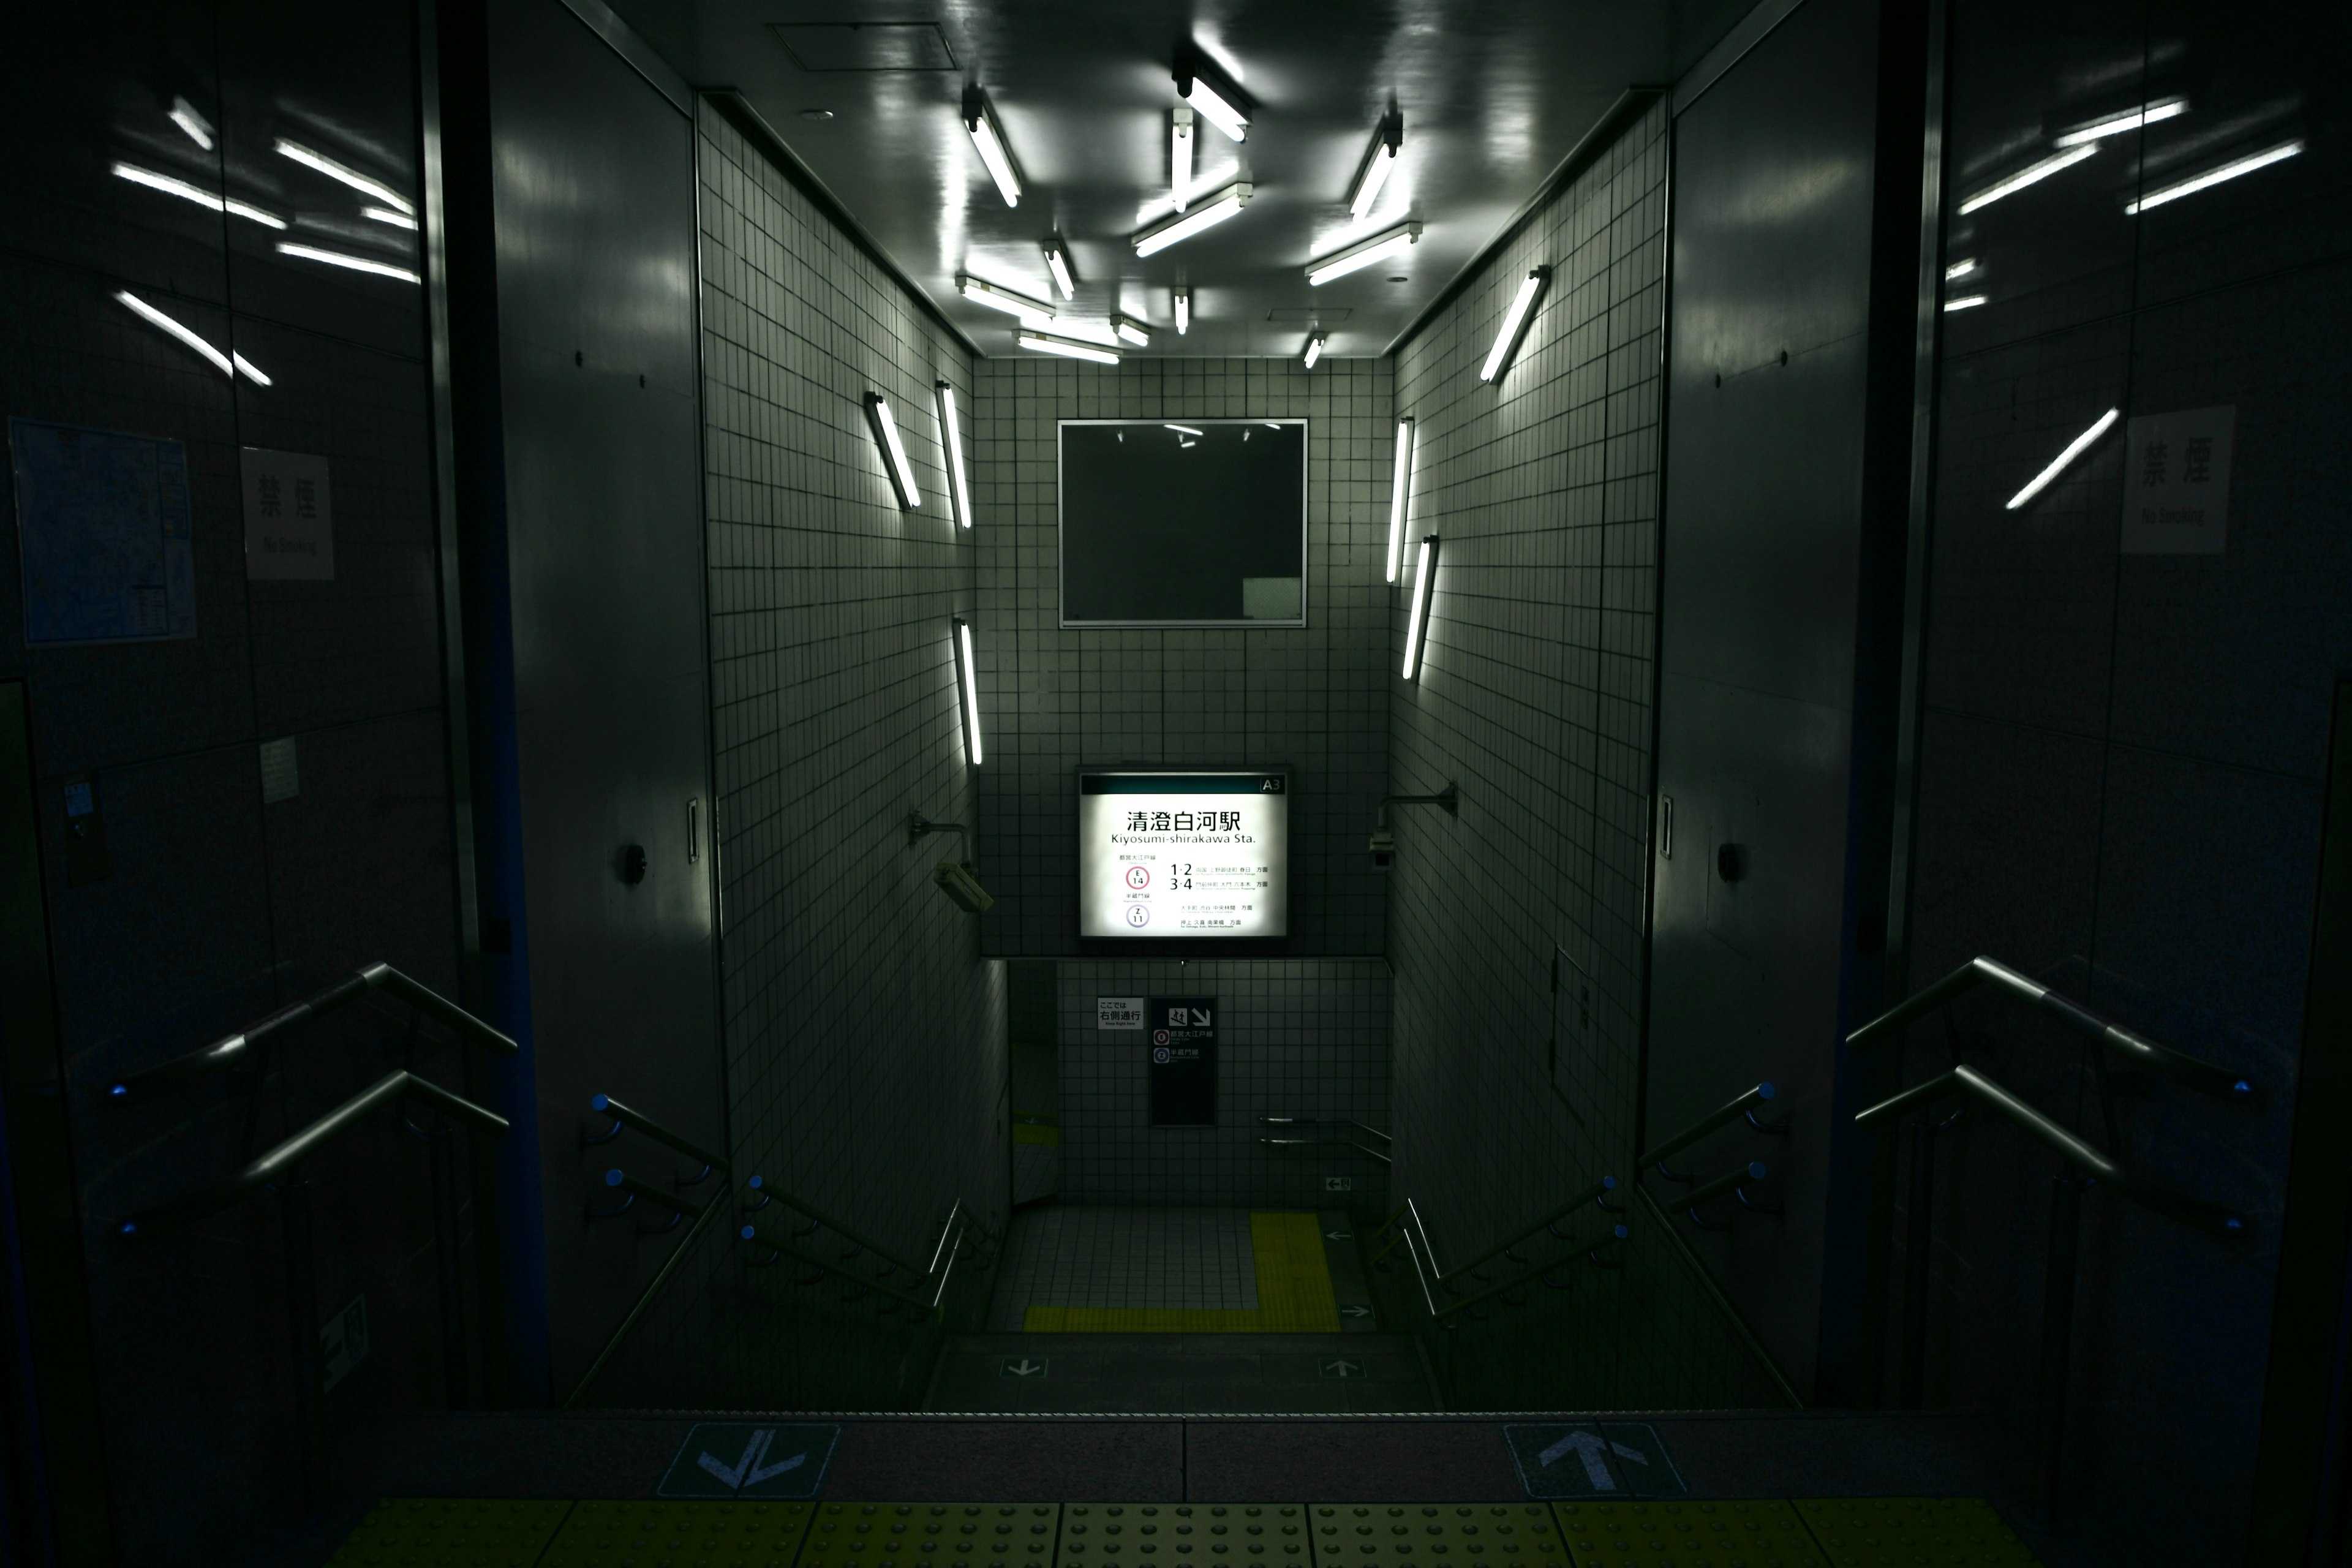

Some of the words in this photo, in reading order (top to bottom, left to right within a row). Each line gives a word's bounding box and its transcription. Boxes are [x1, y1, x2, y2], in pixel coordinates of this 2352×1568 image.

[2143, 436, 2213, 487] 禁煙
[258, 473, 317, 519] 禁煙
[2143, 507, 2157, 525] No
[2159, 507, 2205, 527] Smoking
[264, 537, 277, 553] No
[279, 537, 317, 557] Smoking
[1262, 778, 1281, 790] A3
[1127, 811, 1241, 832] 清澄白河駅
[1111, 834, 1231, 846] Kiyosumi-shirakawa
[1234, 834, 1256, 844] Sta.
[1100, 1011, 1141, 1021] 右側通行
